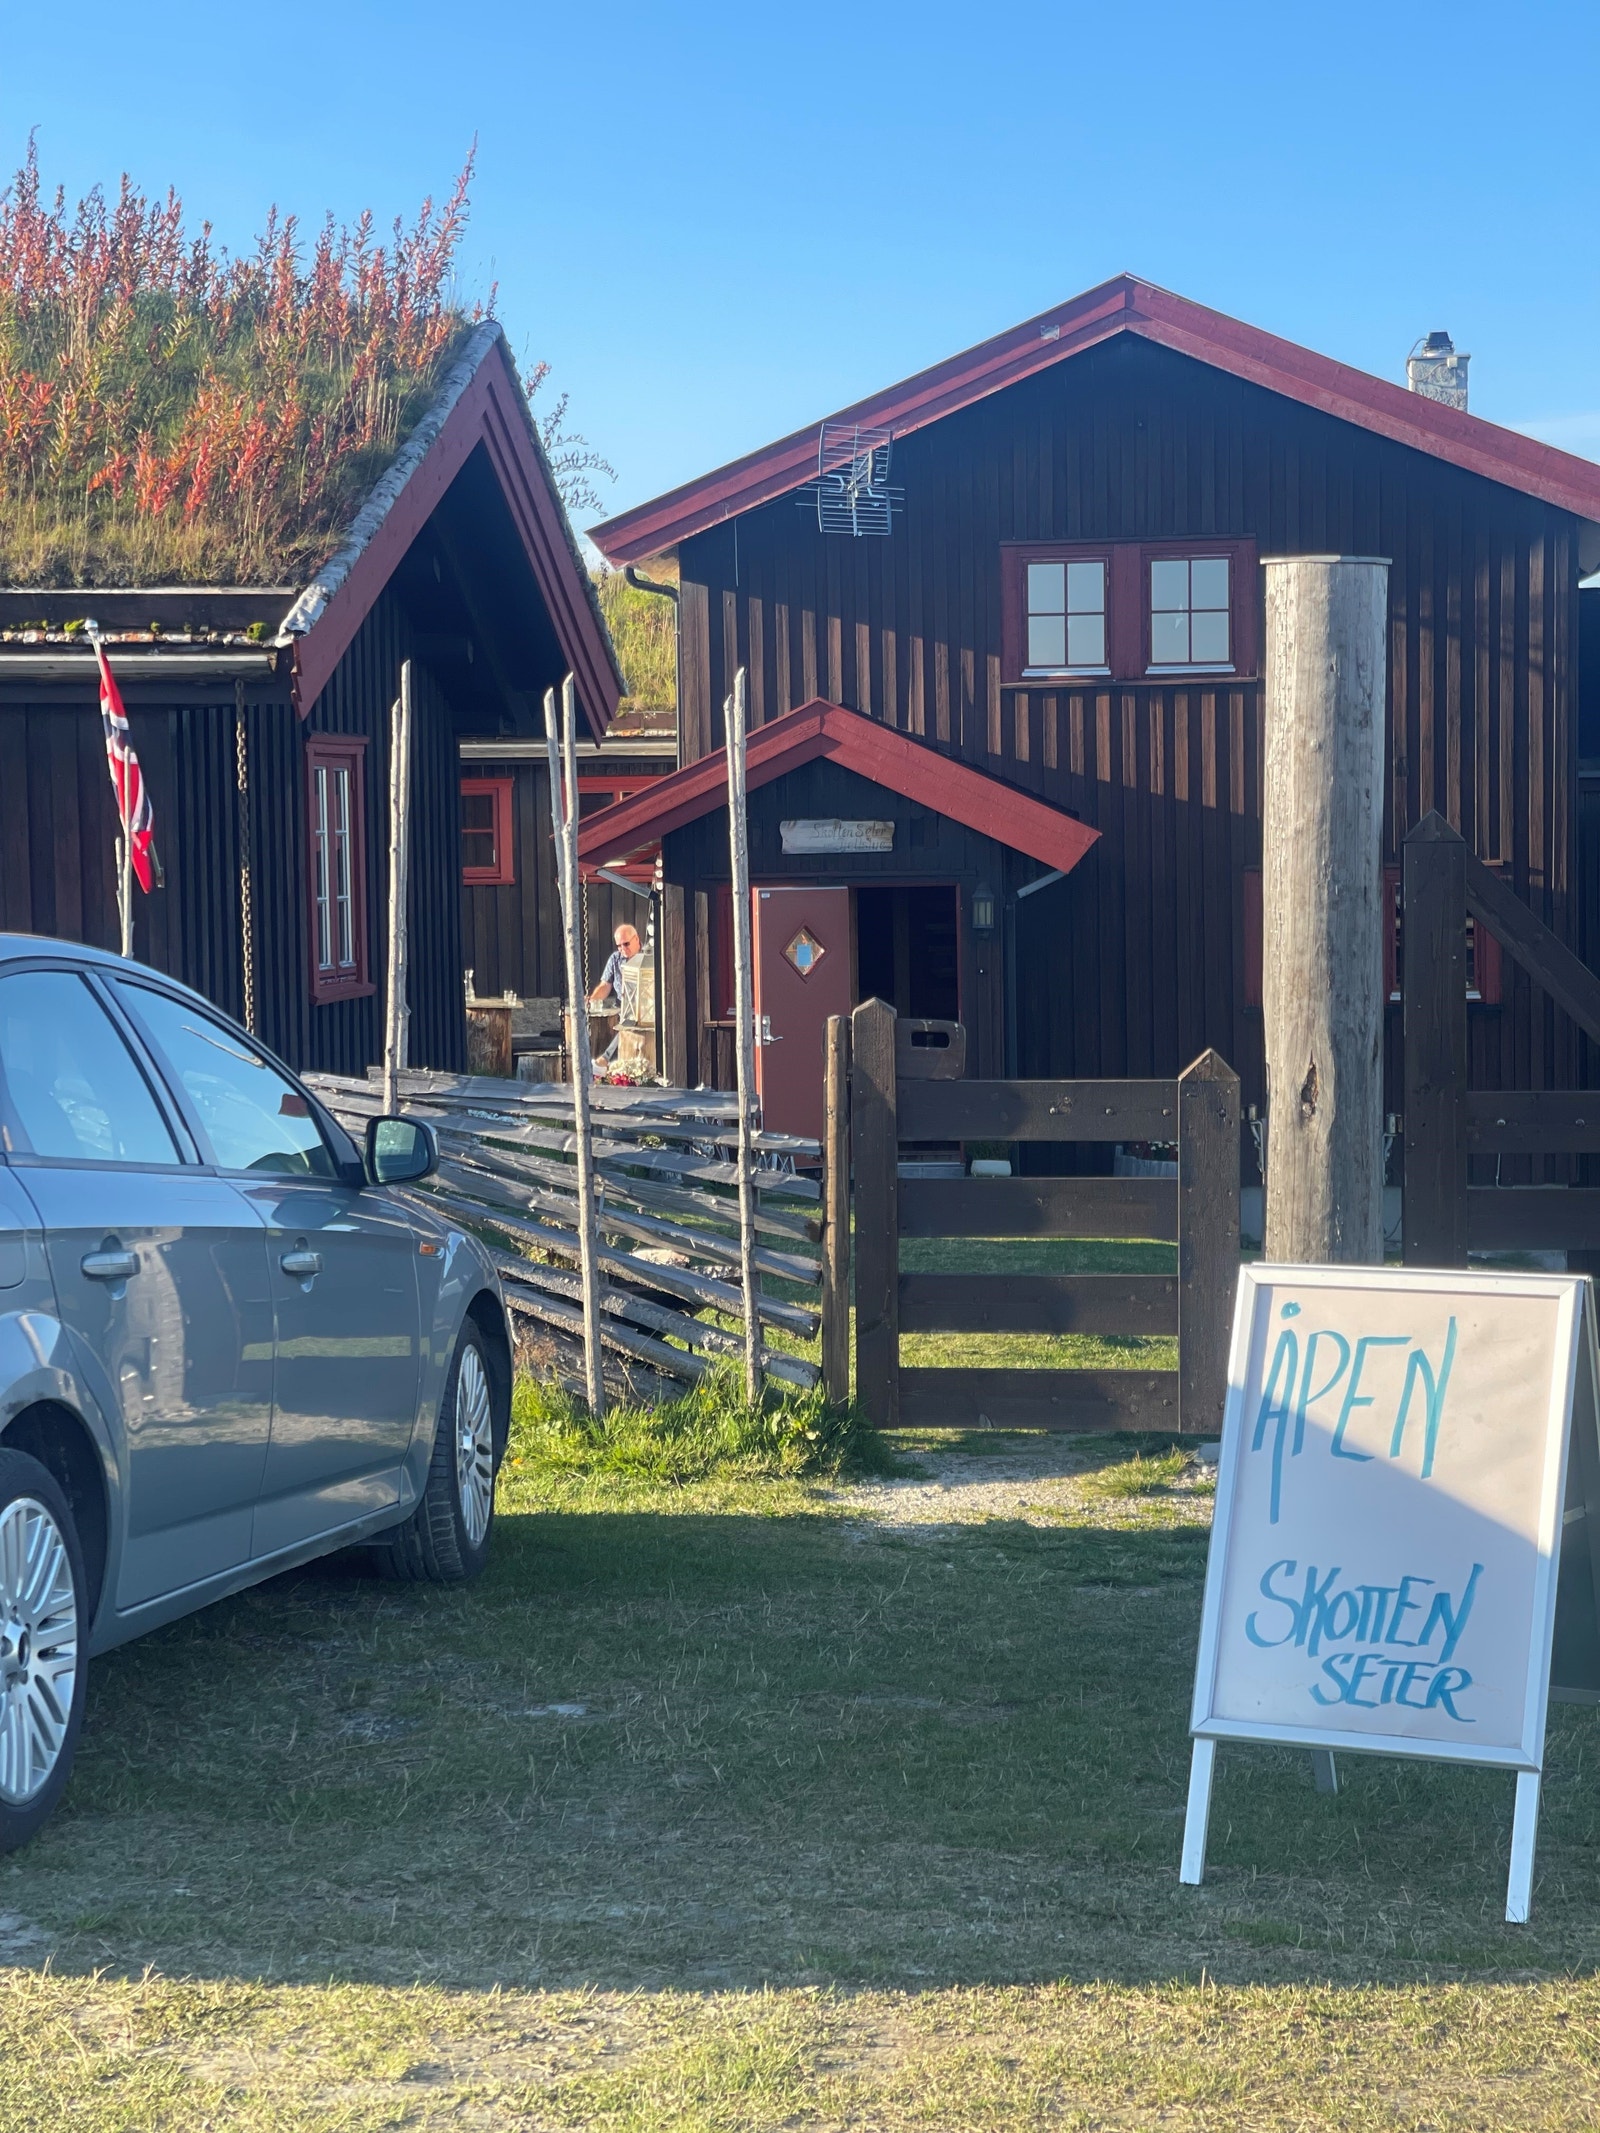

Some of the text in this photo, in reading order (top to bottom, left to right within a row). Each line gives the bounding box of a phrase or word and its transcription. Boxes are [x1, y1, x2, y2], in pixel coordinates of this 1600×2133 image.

[1251, 1302, 1457, 1525] ÅPEN
[1245, 1559, 1484, 1664] SKOTTEN
[1309, 1653, 1477, 1723] SETER
